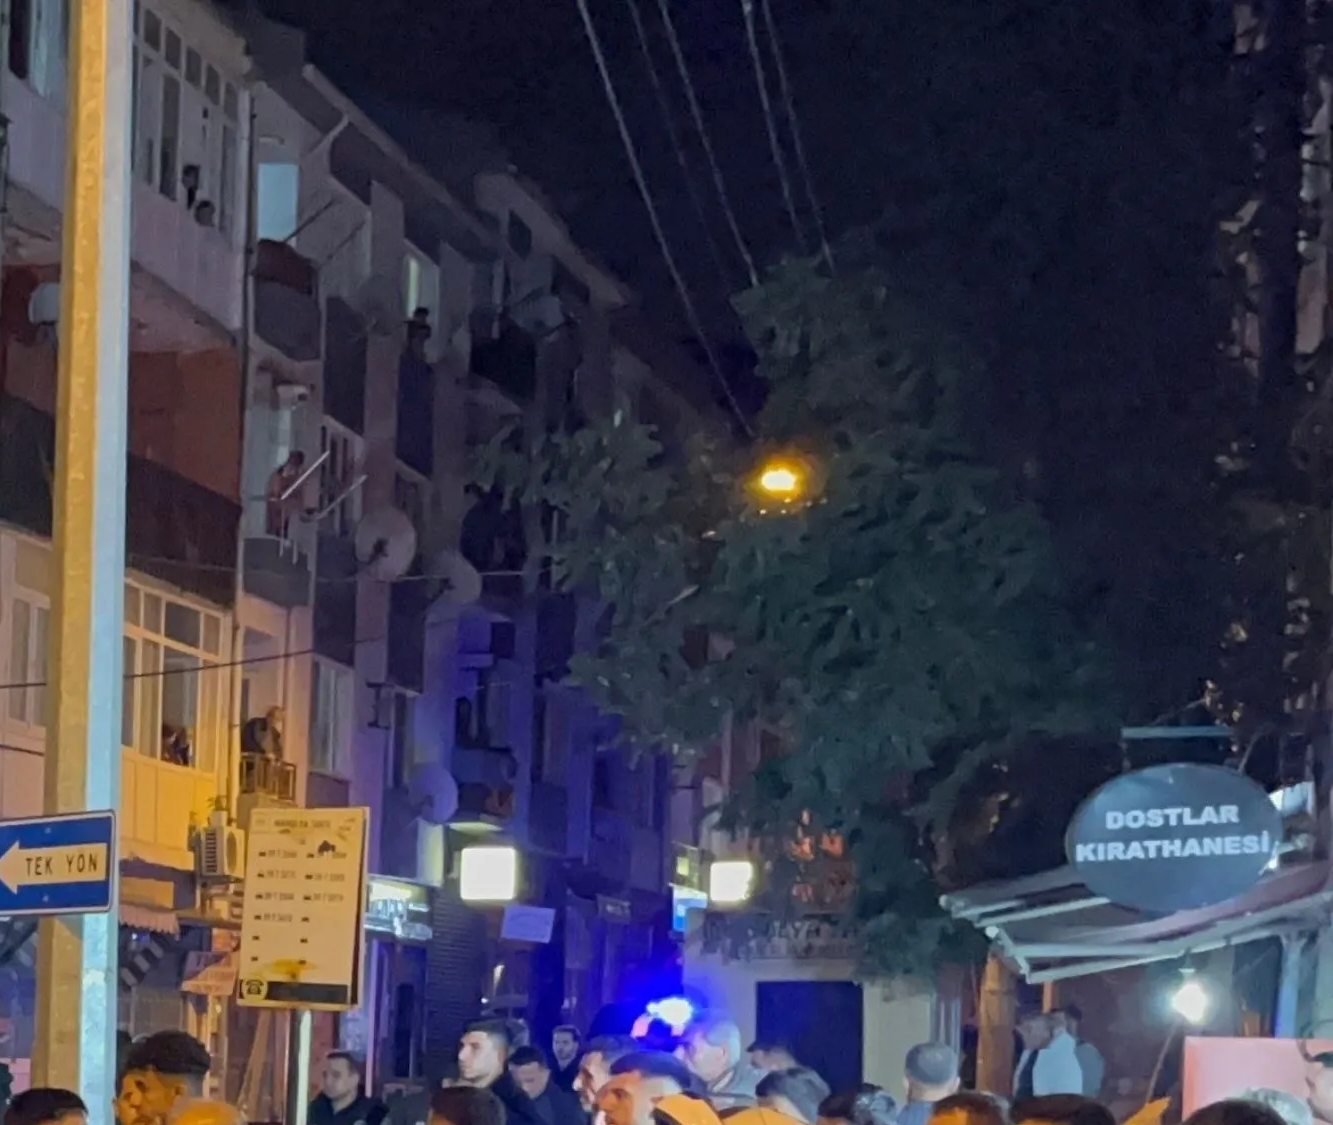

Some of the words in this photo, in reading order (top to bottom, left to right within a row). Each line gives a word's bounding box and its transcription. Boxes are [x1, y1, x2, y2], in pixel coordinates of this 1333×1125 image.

[1105, 804, 1241, 830] DOSTLAR
[1075, 830, 1270, 862] KIRATHANESİ
[25, 855, 53, 877] TEK
